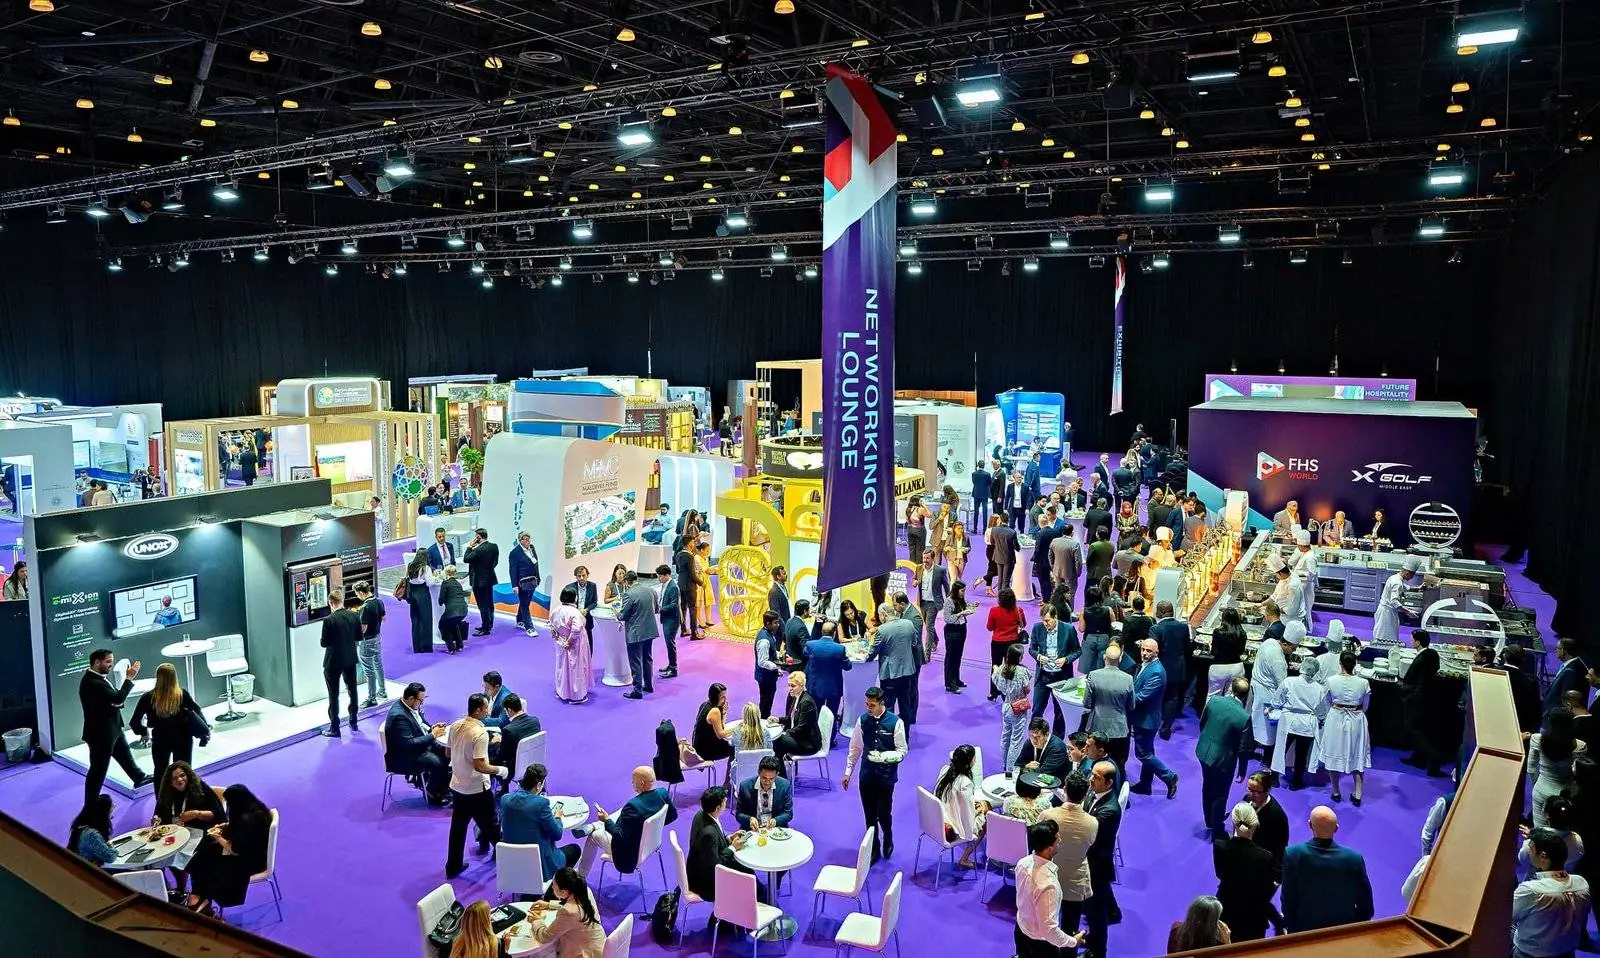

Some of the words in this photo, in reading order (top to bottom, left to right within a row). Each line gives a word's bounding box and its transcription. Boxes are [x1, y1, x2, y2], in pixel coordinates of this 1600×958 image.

[841, 332, 860, 469] LOUNGE
[863, 288, 879, 510] NETWORKING
[1365, 390, 1410, 398] HOSPITALITY
[1288, 458, 1319, 472] FHS
[1288, 472, 1318, 480] WORLD
[903, 477, 925, 494] LANKA
[134, 540, 169, 553] UNOX
